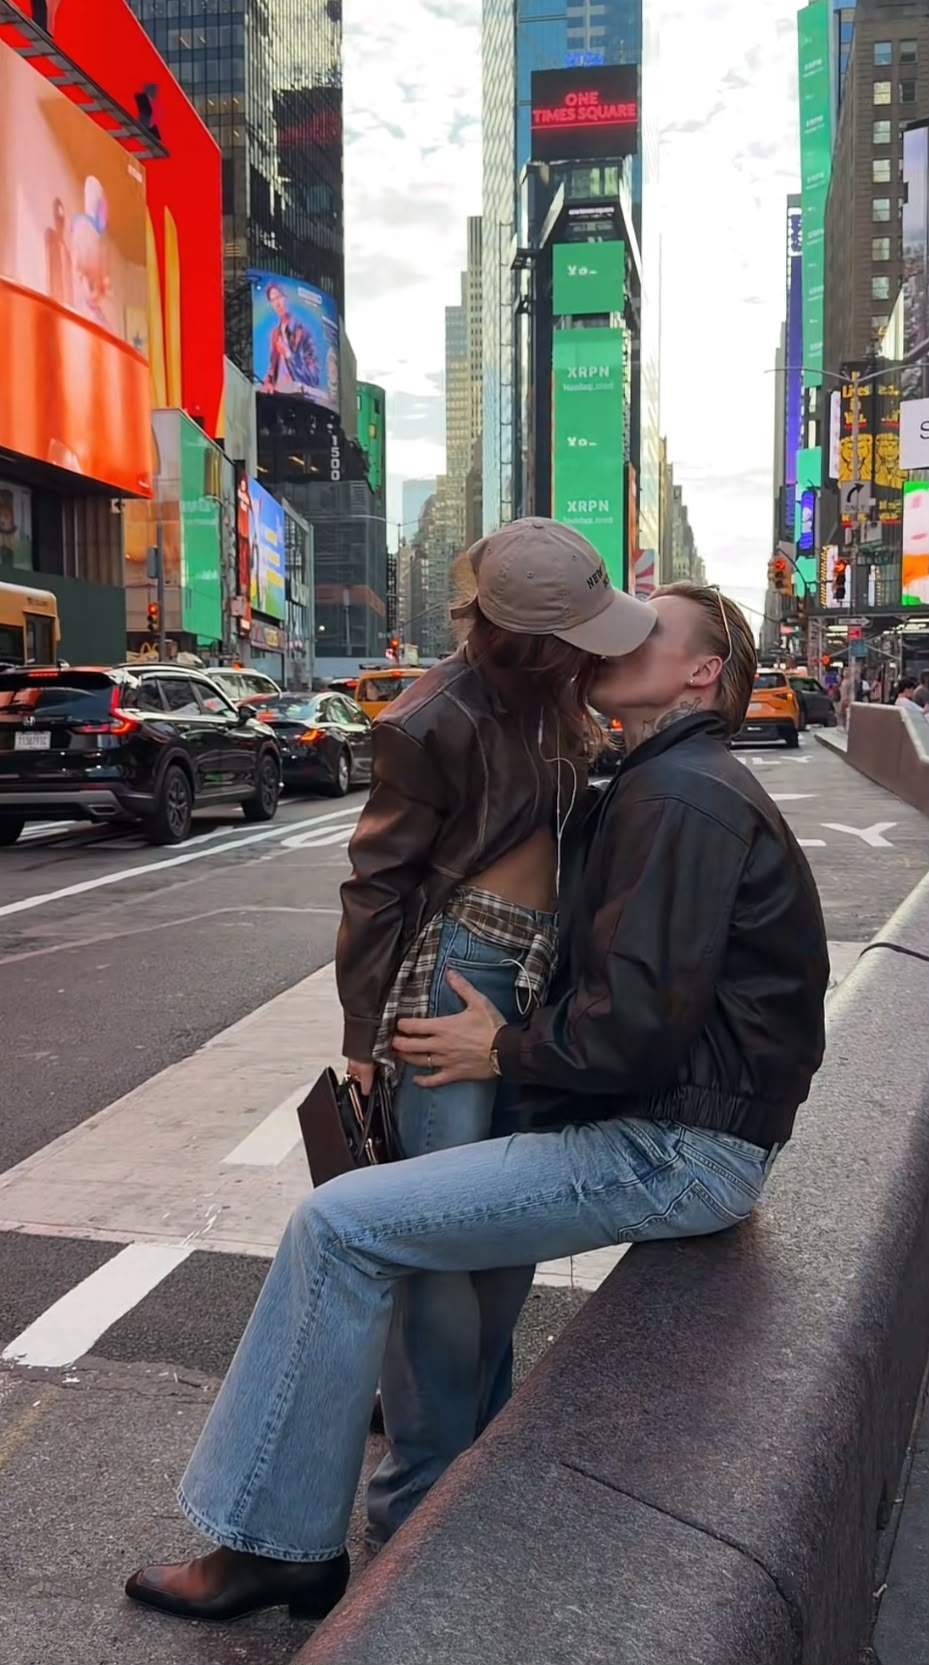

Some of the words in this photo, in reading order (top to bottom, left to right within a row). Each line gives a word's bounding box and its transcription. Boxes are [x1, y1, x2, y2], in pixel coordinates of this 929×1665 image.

[565, 91, 599, 106] ONE
[533, 108, 576, 122] TIMES
[577, 104, 636, 120] SQUARE
[567, 366, 610, 378] XRPN
[331, 434, 340, 481] 1500
[567, 499, 609, 512] XRPN
